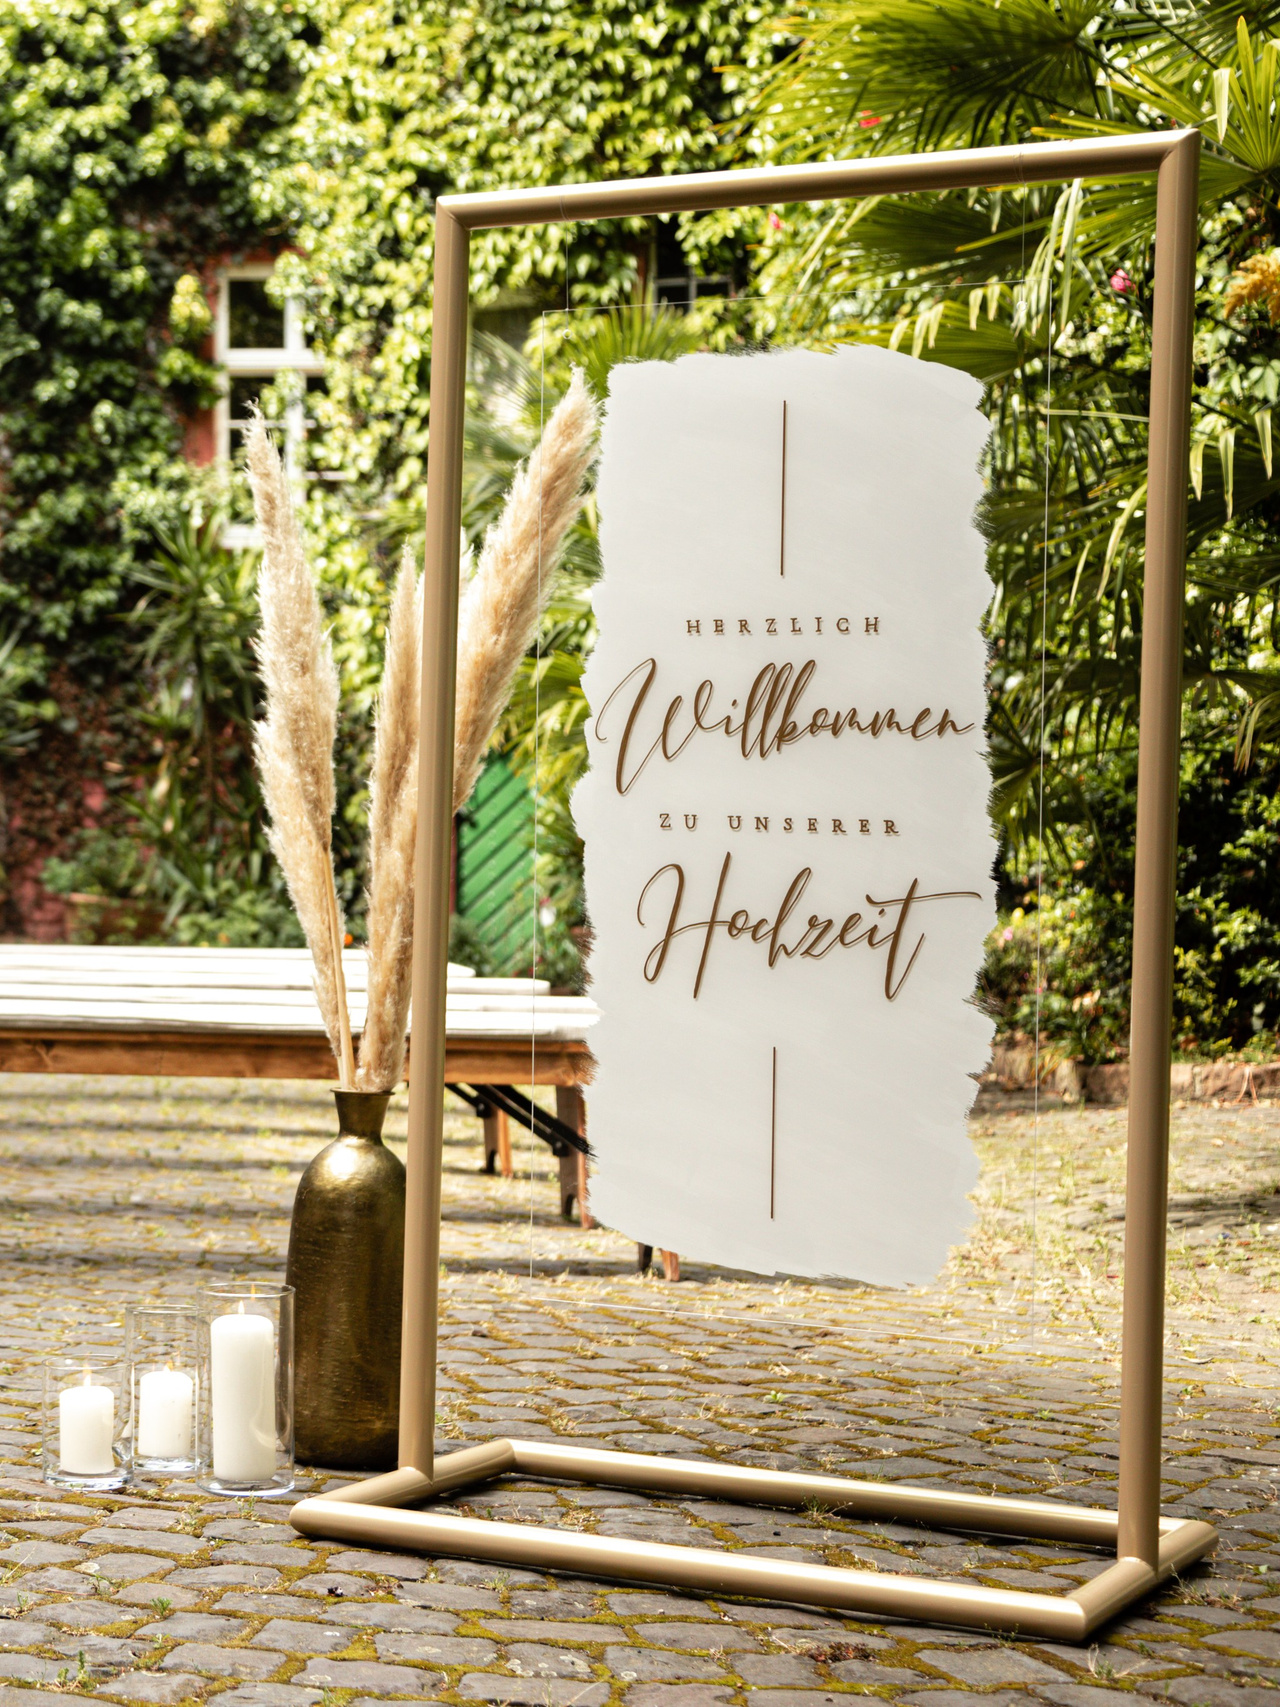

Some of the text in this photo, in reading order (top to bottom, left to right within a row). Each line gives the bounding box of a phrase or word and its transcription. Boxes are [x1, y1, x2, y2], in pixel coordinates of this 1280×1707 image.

[686, 616, 880, 635] HERZLICH
[594, 657, 975, 795] Willkommen
[659, 813, 901, 836] ZU UNSERER
[636, 851, 982, 1000] Hochzeit
